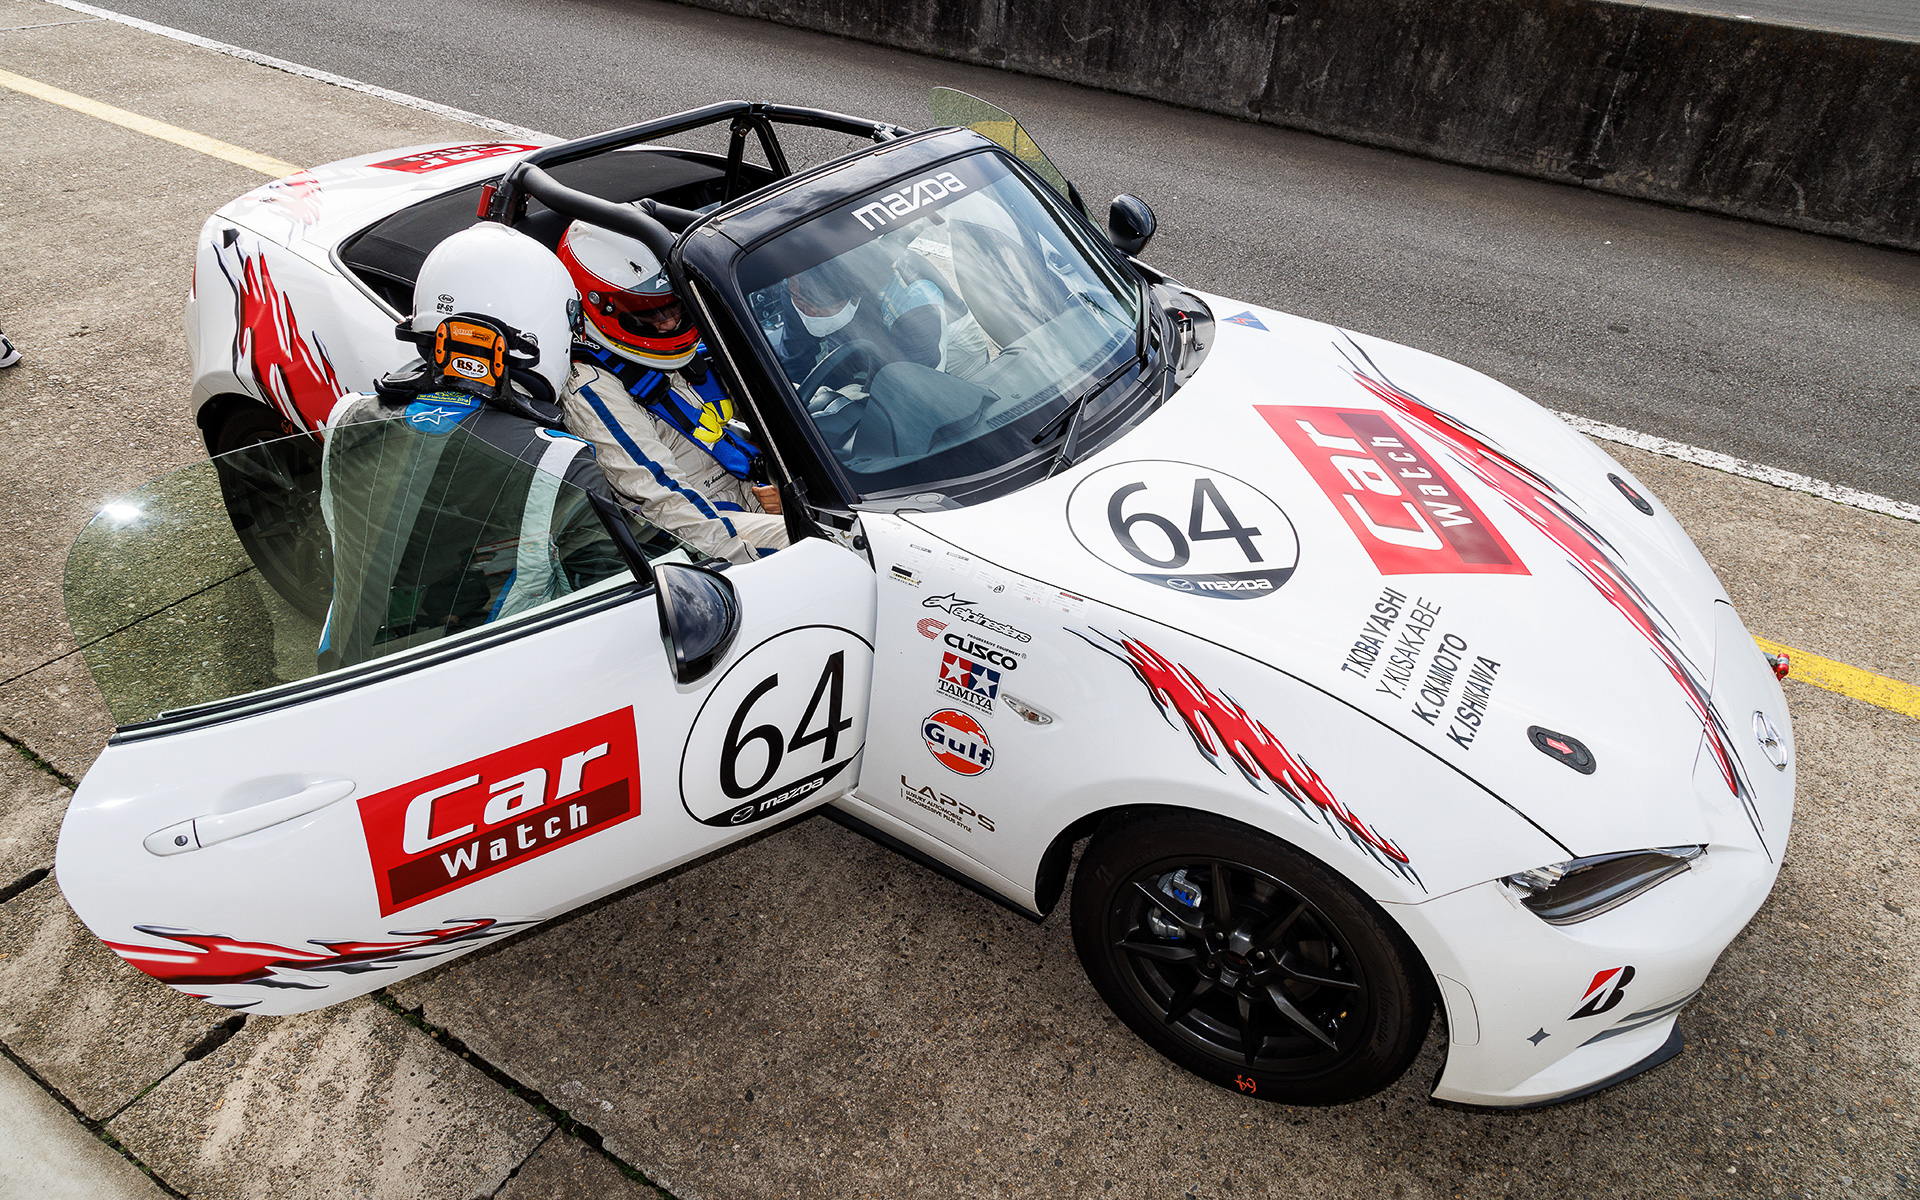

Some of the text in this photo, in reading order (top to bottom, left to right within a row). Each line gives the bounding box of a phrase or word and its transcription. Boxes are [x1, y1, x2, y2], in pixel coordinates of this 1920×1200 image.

[403, 145, 487, 162] Watch
[420, 145, 523, 169] Car
[852, 171, 967, 231] mazda
[457, 359, 485, 374] RS.2
[1295, 419, 1444, 550] Car
[1370, 436, 1473, 527] Watch
[1107, 478, 1264, 569] 64
[1197, 578, 1273, 591] mazda
[952, 607, 1032, 643] alpinestars
[1341, 586, 1407, 679] T.KOBAYASHI
[1376, 597, 1441, 699] Y.KUSAKABE
[938, 679, 993, 711] TAMIYA
[1411, 633, 1467, 726] K.OKAMOTO
[1446, 655, 1501, 751] K.ISHIKAWA
[719, 650, 853, 799] 64
[924, 722, 992, 765] Gulf
[403, 742, 611, 854] Car
[759, 777, 824, 812] mazda
[901, 775, 995, 832] LAPPS
[906, 790, 962, 822] LUXURY AUTOMOBILE
[906, 796, 942, 817] PROGRESSIVE
[440, 803, 588, 878] Watch
